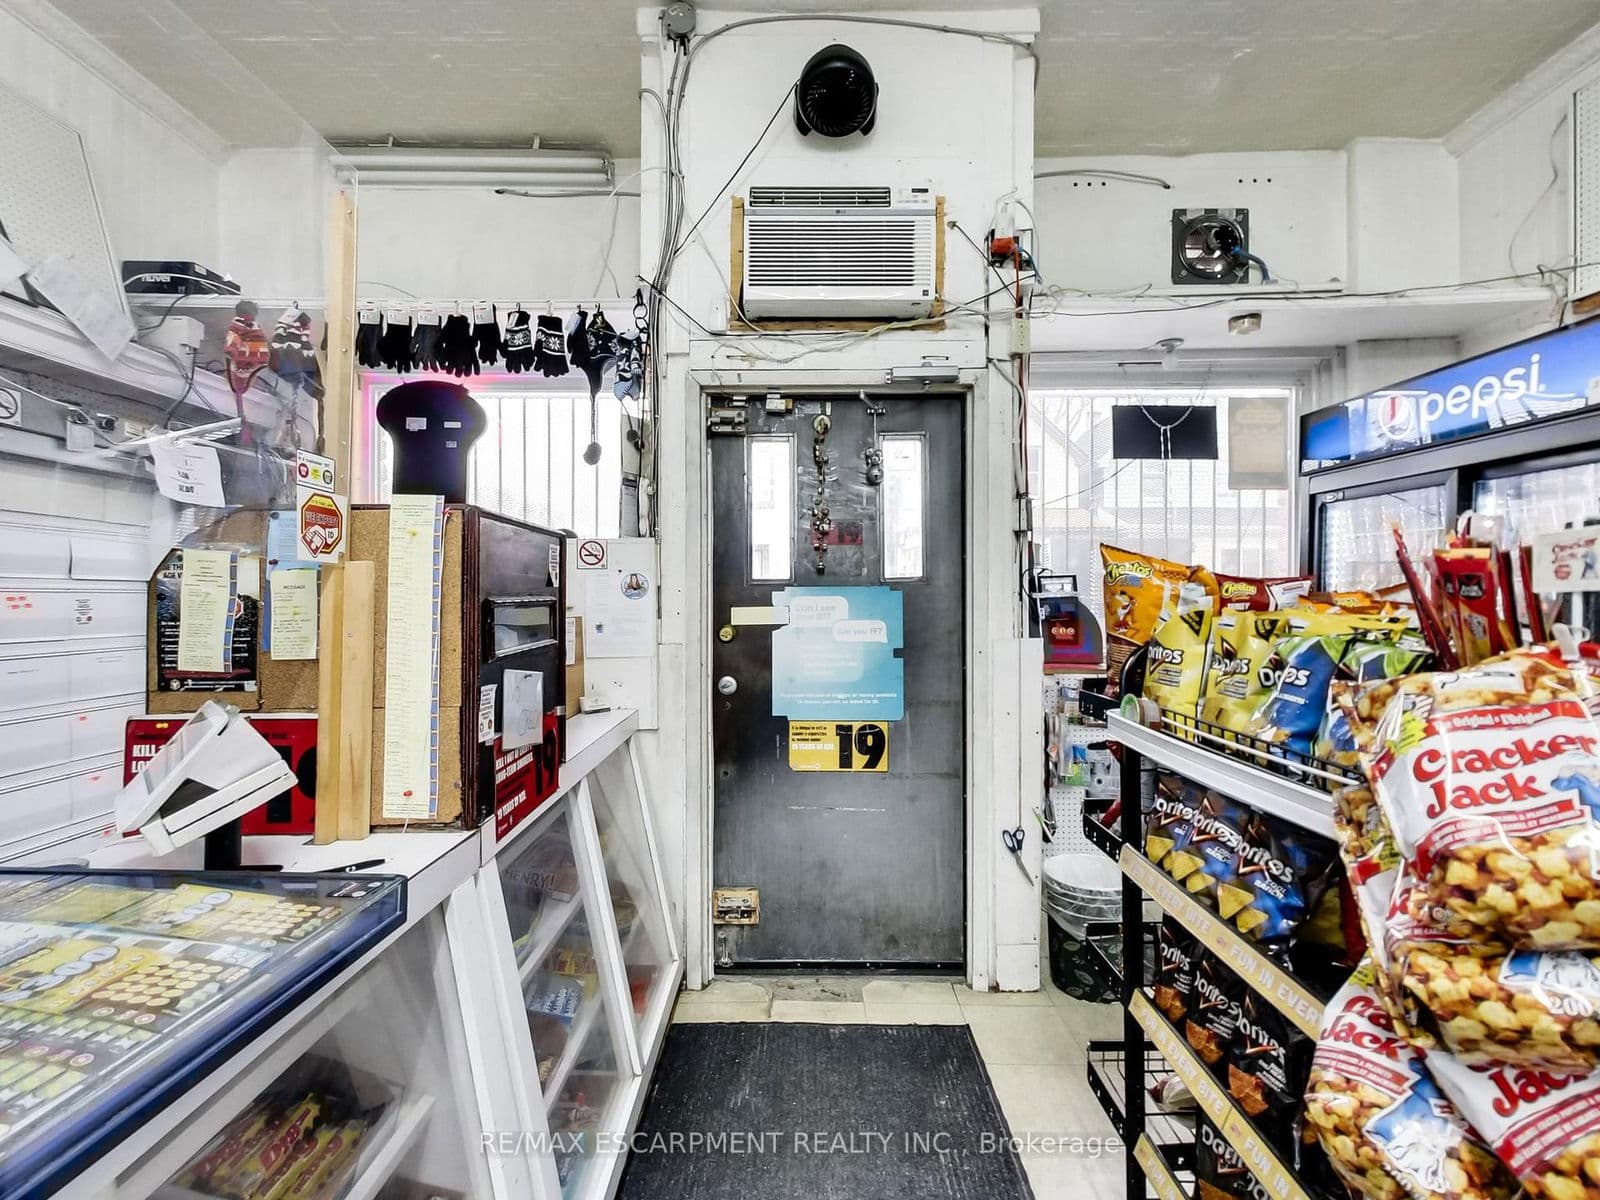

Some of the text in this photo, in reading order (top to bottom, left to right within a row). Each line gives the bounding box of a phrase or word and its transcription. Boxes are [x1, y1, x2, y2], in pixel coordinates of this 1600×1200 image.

[1420, 353, 1541, 422] pepsi
[1107, 561, 1152, 582] Cheetos
[1222, 582, 1257, 597] Cheetos
[132, 744, 156, 757] KILL
[836, 724, 886, 769] 19
[1413, 735, 1598, 782] Cracker
[1427, 773, 1547, 819] Jack
[1230, 946, 1259, 973] FUN
[1258, 970, 1276, 990] IN
[1276, 984, 1319, 1024] EVER
[1321, 1014, 1408, 1062] Jack
[1488, 1068, 1587, 1117] Jac
[1243, 1138, 1271, 1174] FUN
[1273, 1174, 1291, 1198] IN
